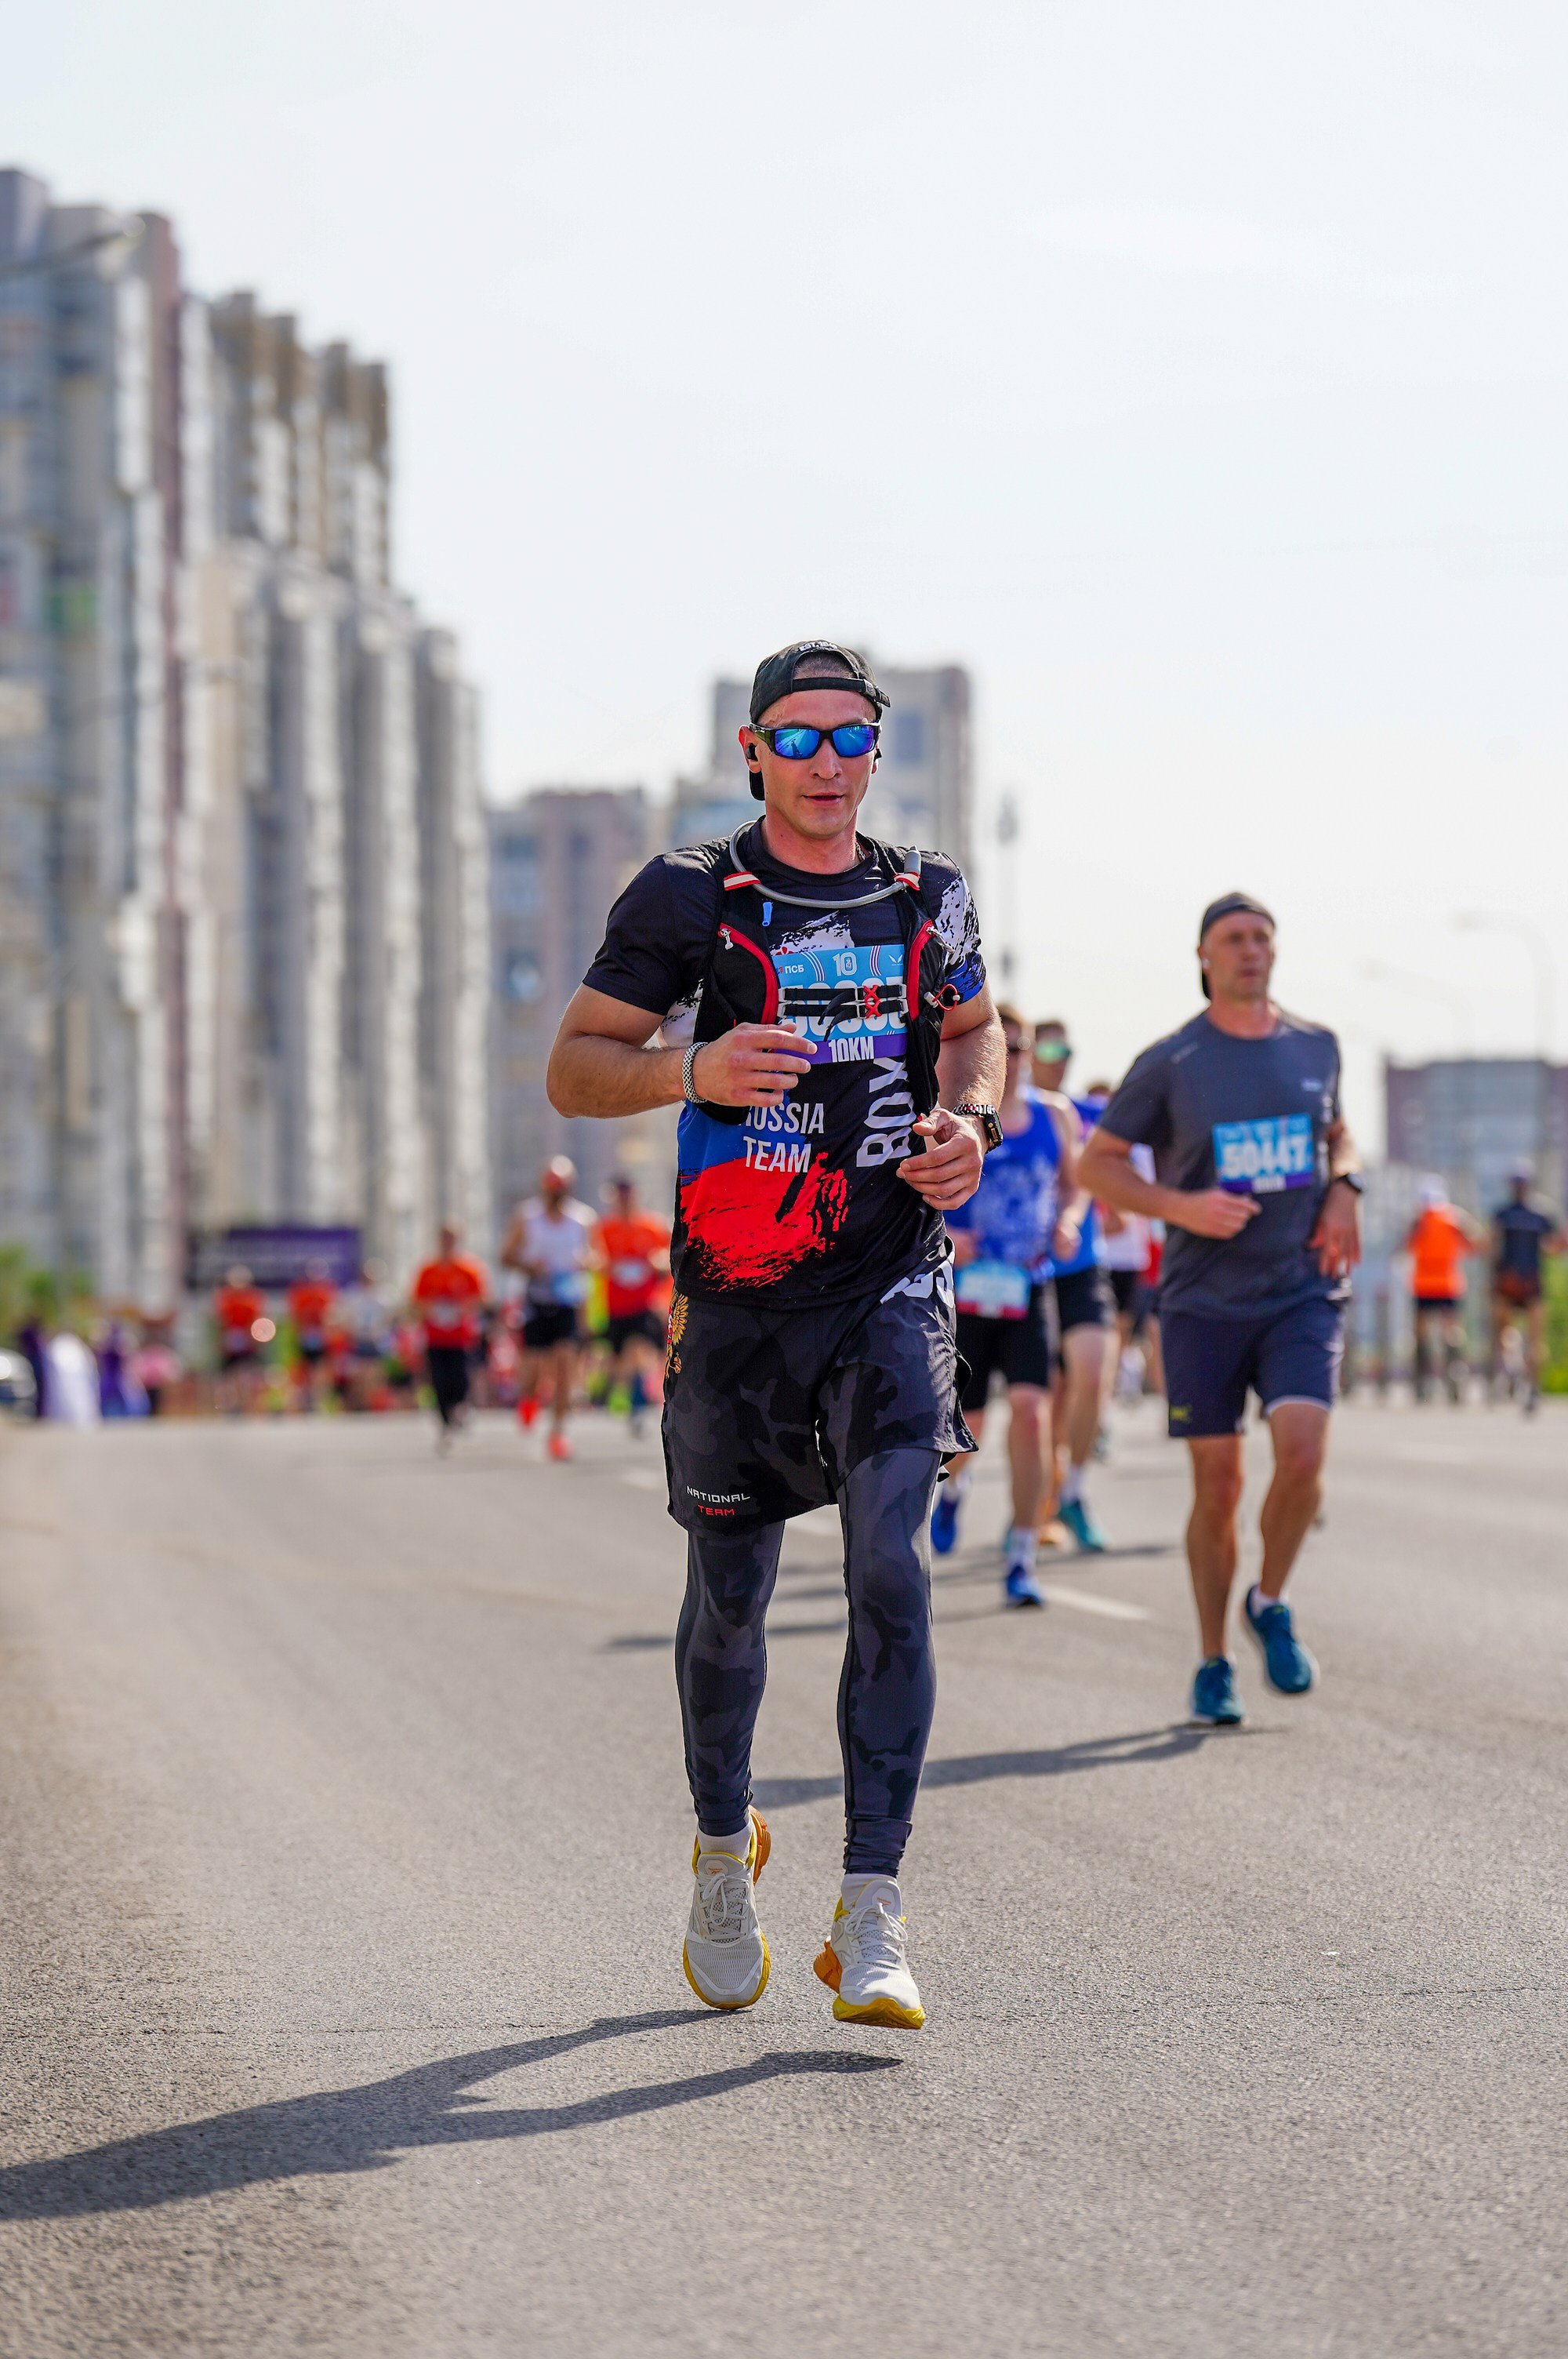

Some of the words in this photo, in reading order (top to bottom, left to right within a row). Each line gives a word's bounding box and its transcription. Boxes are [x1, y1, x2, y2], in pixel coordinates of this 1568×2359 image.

[785, 964, 804, 974] ПСБ
[833, 952, 858, 976] 10
[829, 1036, 875, 1063] 10KM
[743, 1136, 812, 1173] TEAM
[686, 1485, 751, 1503] NATIONAL
[698, 1504, 735, 1517] TEAM
